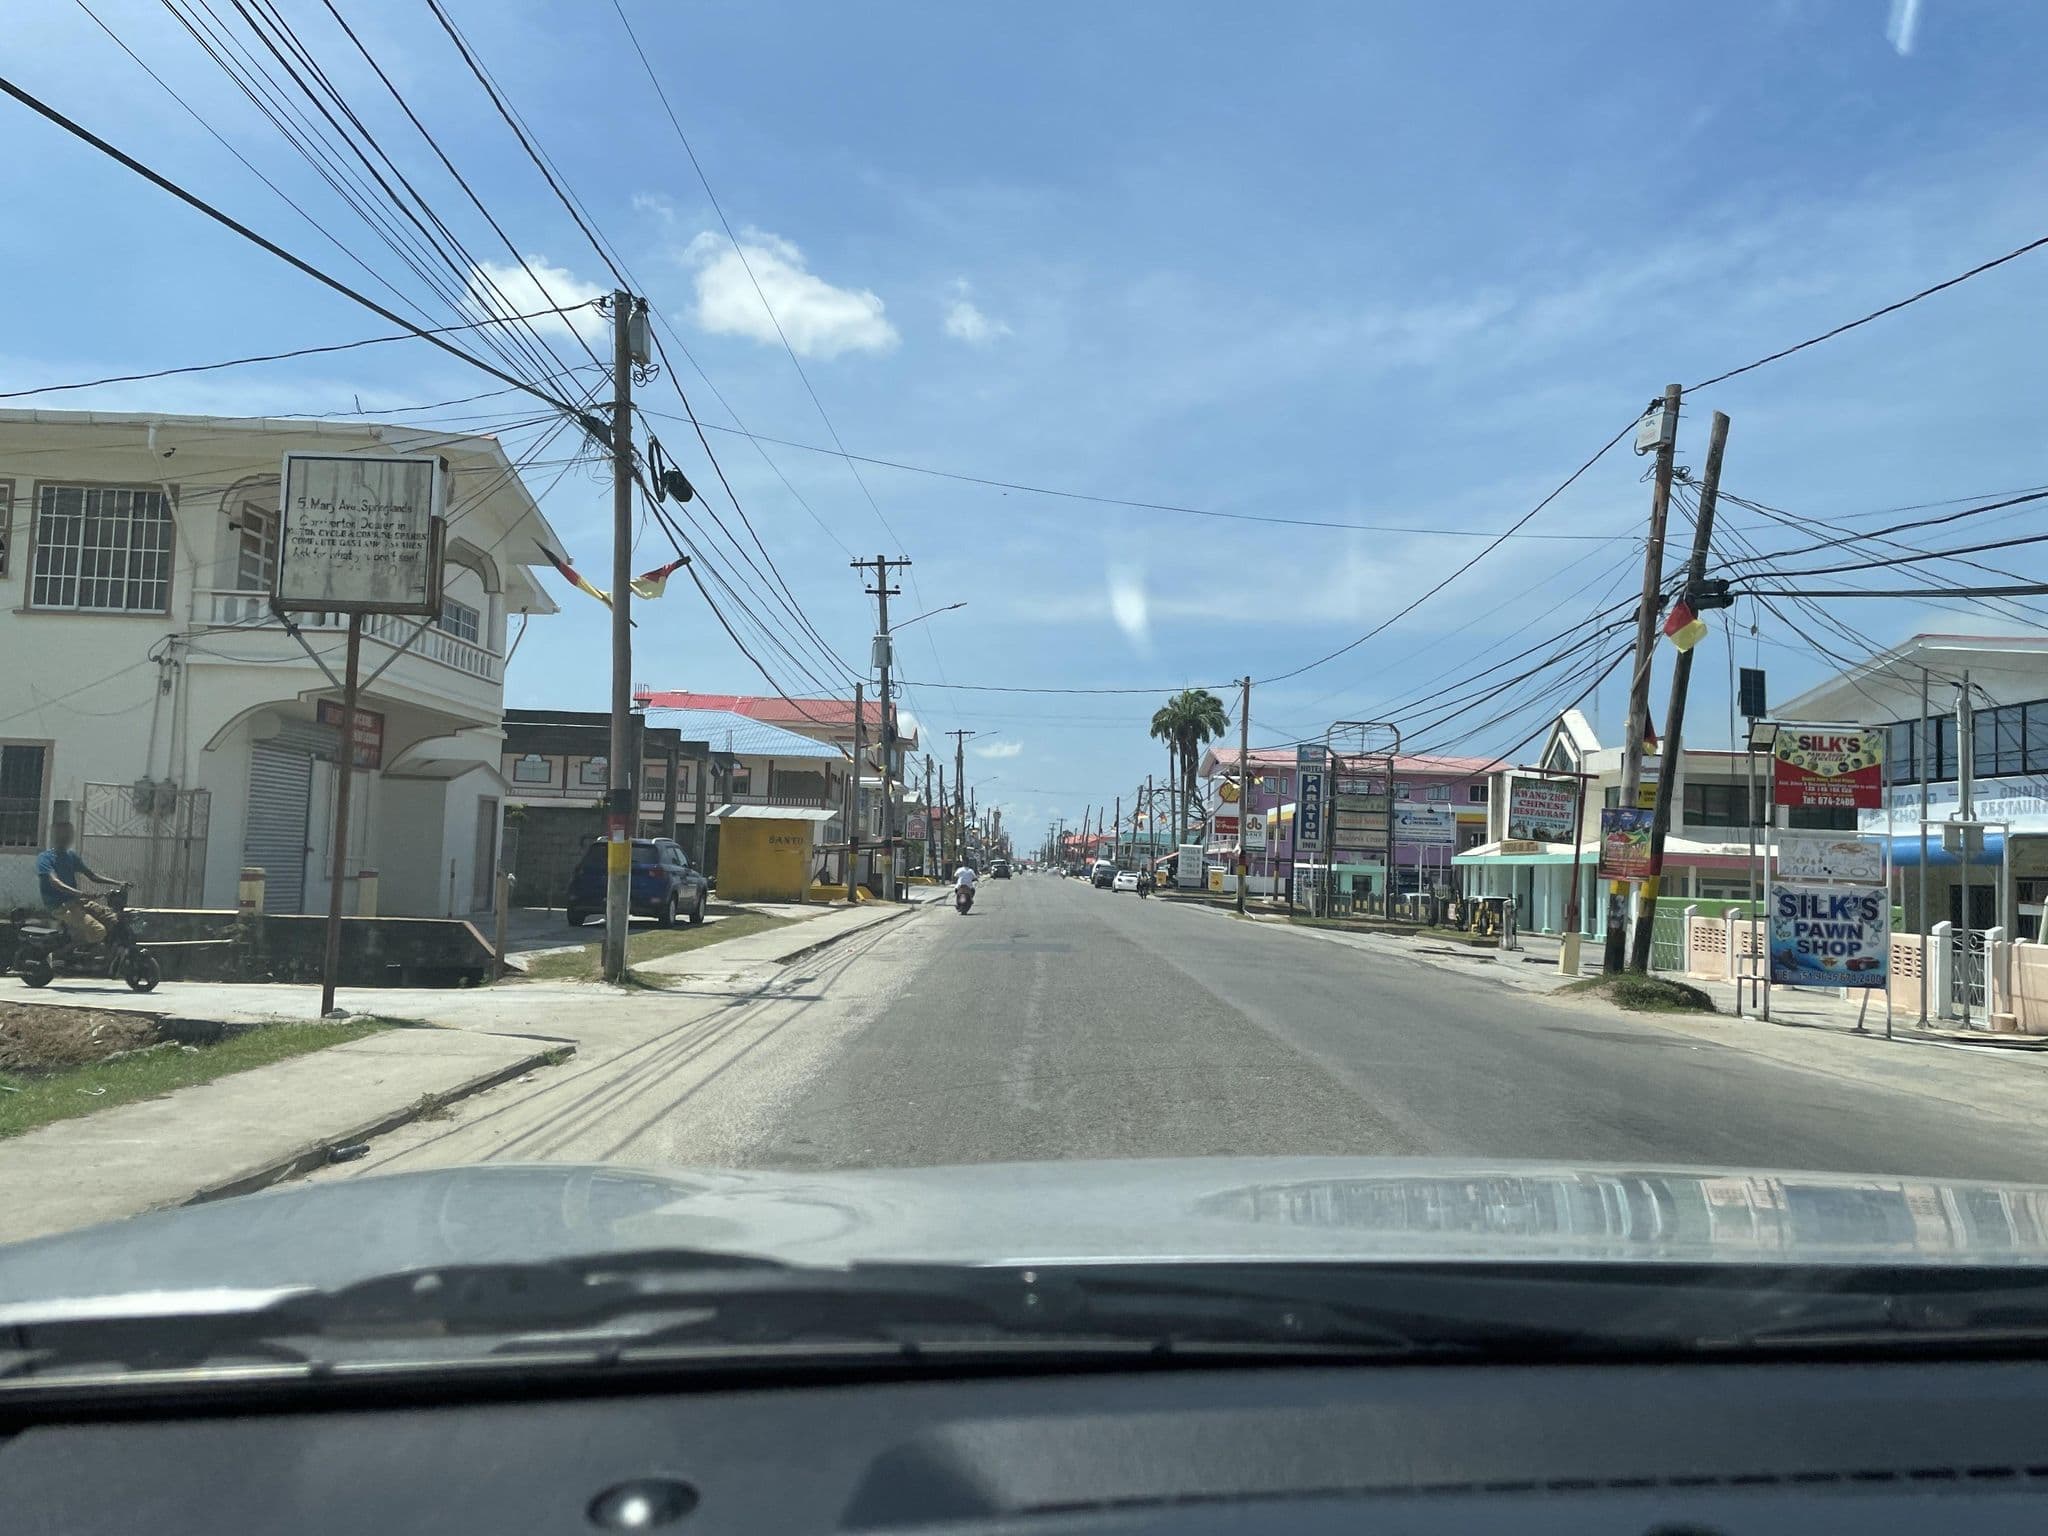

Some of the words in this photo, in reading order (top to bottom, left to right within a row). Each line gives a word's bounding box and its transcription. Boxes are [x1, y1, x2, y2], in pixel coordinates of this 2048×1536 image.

[311, 497, 335, 514] Mary
[361, 499, 413, 516] Springlands
[1798, 734, 1861, 753] SILK'S
[1301, 765, 1322, 773] HOTEL
[1305, 775, 1318, 839] PARATON
[1513, 807, 1571, 819] RESTAURANT
[1520, 800, 1567, 811] CHINESE
[1302, 841, 1317, 849] INN
[1779, 893, 1880, 921] SILK'S
[1795, 922, 1864, 940] PAWN
[1796, 940, 1863, 957] SHOP
